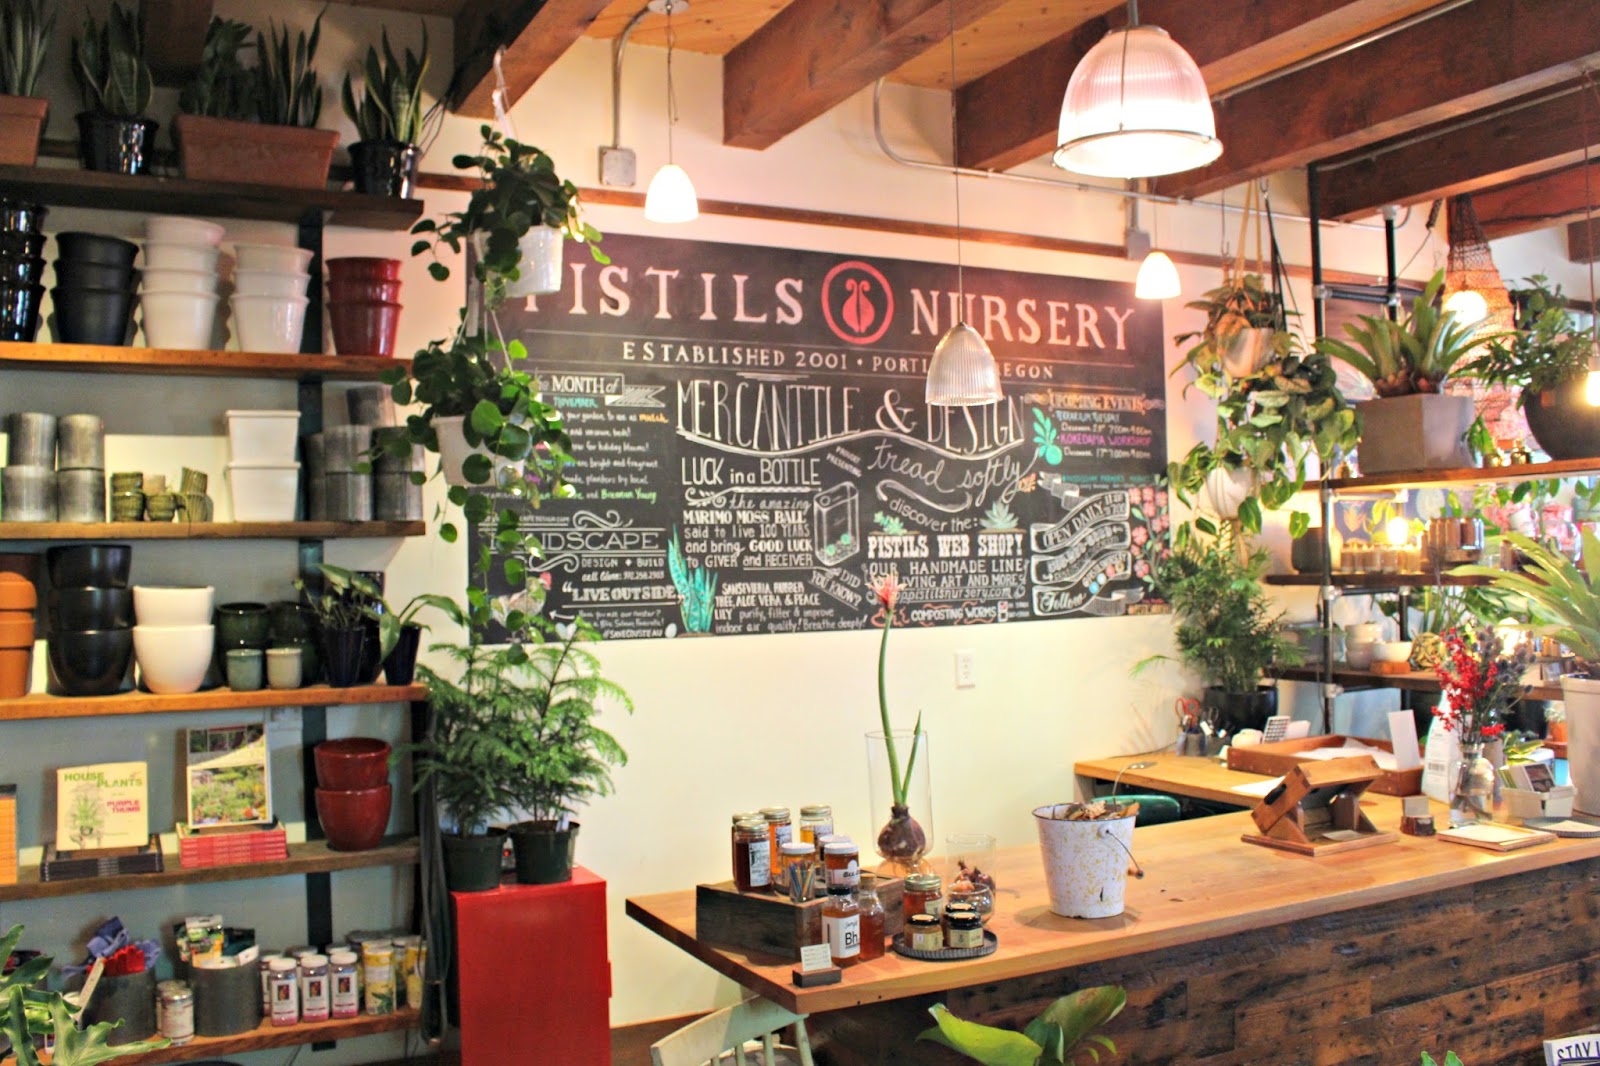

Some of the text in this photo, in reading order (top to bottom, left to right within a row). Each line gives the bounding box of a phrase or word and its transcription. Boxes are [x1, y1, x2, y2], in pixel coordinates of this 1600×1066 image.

[523, 262, 1136, 351] ISTILS NURSERY
[623, 341, 1053, 379] ESTABLISHED 2001 PORTL EGON
[551, 375, 605, 393] MONTH
[605, 377, 620, 393] of
[676, 379, 1025, 455] MERCANTILE & DESIGN
[682, 457, 724, 485] LUCK
[760, 457, 821, 485] BOTTLE
[868, 438, 1039, 507] tread softly
[729, 493, 812, 515] the amazing
[682, 510, 732, 525] MARIMO
[736, 510, 770, 524] MOSS
[889, 498, 948, 532] discover
[1042, 524, 1072, 548] OPEN
[1071, 500, 1106, 532] DAILY
[684, 523, 811, 539] said to live 100 YEARS
[685, 538, 814, 558] and bring GOOD LUCK
[867, 535, 930, 559] PISTILS
[937, 534, 970, 557] WEB
[582, 557, 664, 568] DESIGN BUILD
[686, 553, 814, 568] to GIVER and RECEIVER
[869, 558, 1024, 576] OUR HANDMADE LINE
[840, 569, 861, 588] DID
[899, 576, 936, 588] IVING
[940, 576, 962, 588] ART
[967, 575, 988, 587] AND
[992, 574, 1018, 586] MORE
[811, 570, 830, 589] YOU
[829, 580, 863, 607] KNOW?
[758, 594, 782, 607] VERA
[784, 595, 793, 606] &
[794, 593, 821, 606] PEACE
[1040, 590, 1086, 613] Follow
[714, 608, 733, 620] LILY
[911, 607, 964, 622] COMPOSTING
[965, 606, 997, 618] WORMS
[715, 621, 742, 633] indoor
[746, 622, 760, 632] air
[803, 619, 836, 631] Breathe
[64, 772, 104, 781] HOUSE
[97, 778, 143, 788] PLANTS
[107, 799, 140, 807] PURPLE
[1557, 1041, 1591, 1060] STAY
